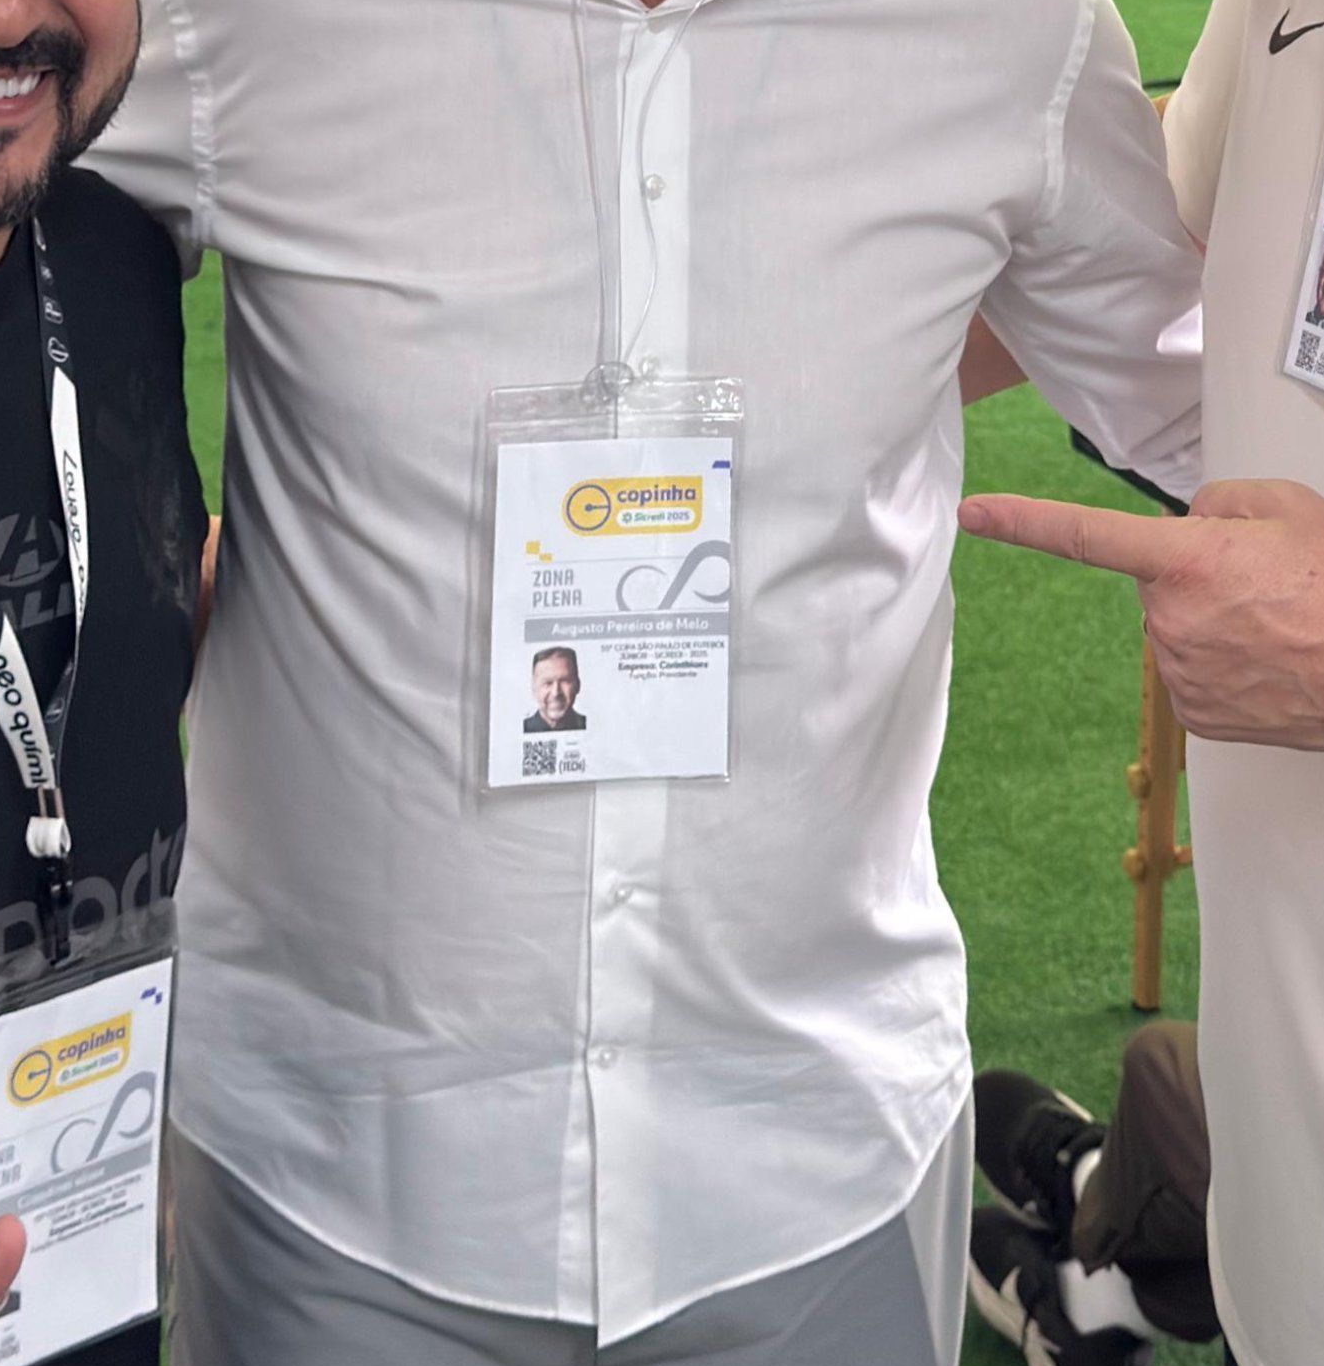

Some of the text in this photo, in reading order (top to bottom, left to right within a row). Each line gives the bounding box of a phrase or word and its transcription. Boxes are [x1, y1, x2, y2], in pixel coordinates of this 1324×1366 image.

[617, 484, 696, 507] copinha
[667, 512, 690, 522] 2025
[533, 569, 574, 588] ZONA
[532, 589, 583, 608] PLENA
[551, 621, 604, 638] Augusto
[607, 620, 653, 634] Pereira
[656, 619, 673, 631] de
[57, 1026, 126, 1062] copinha
